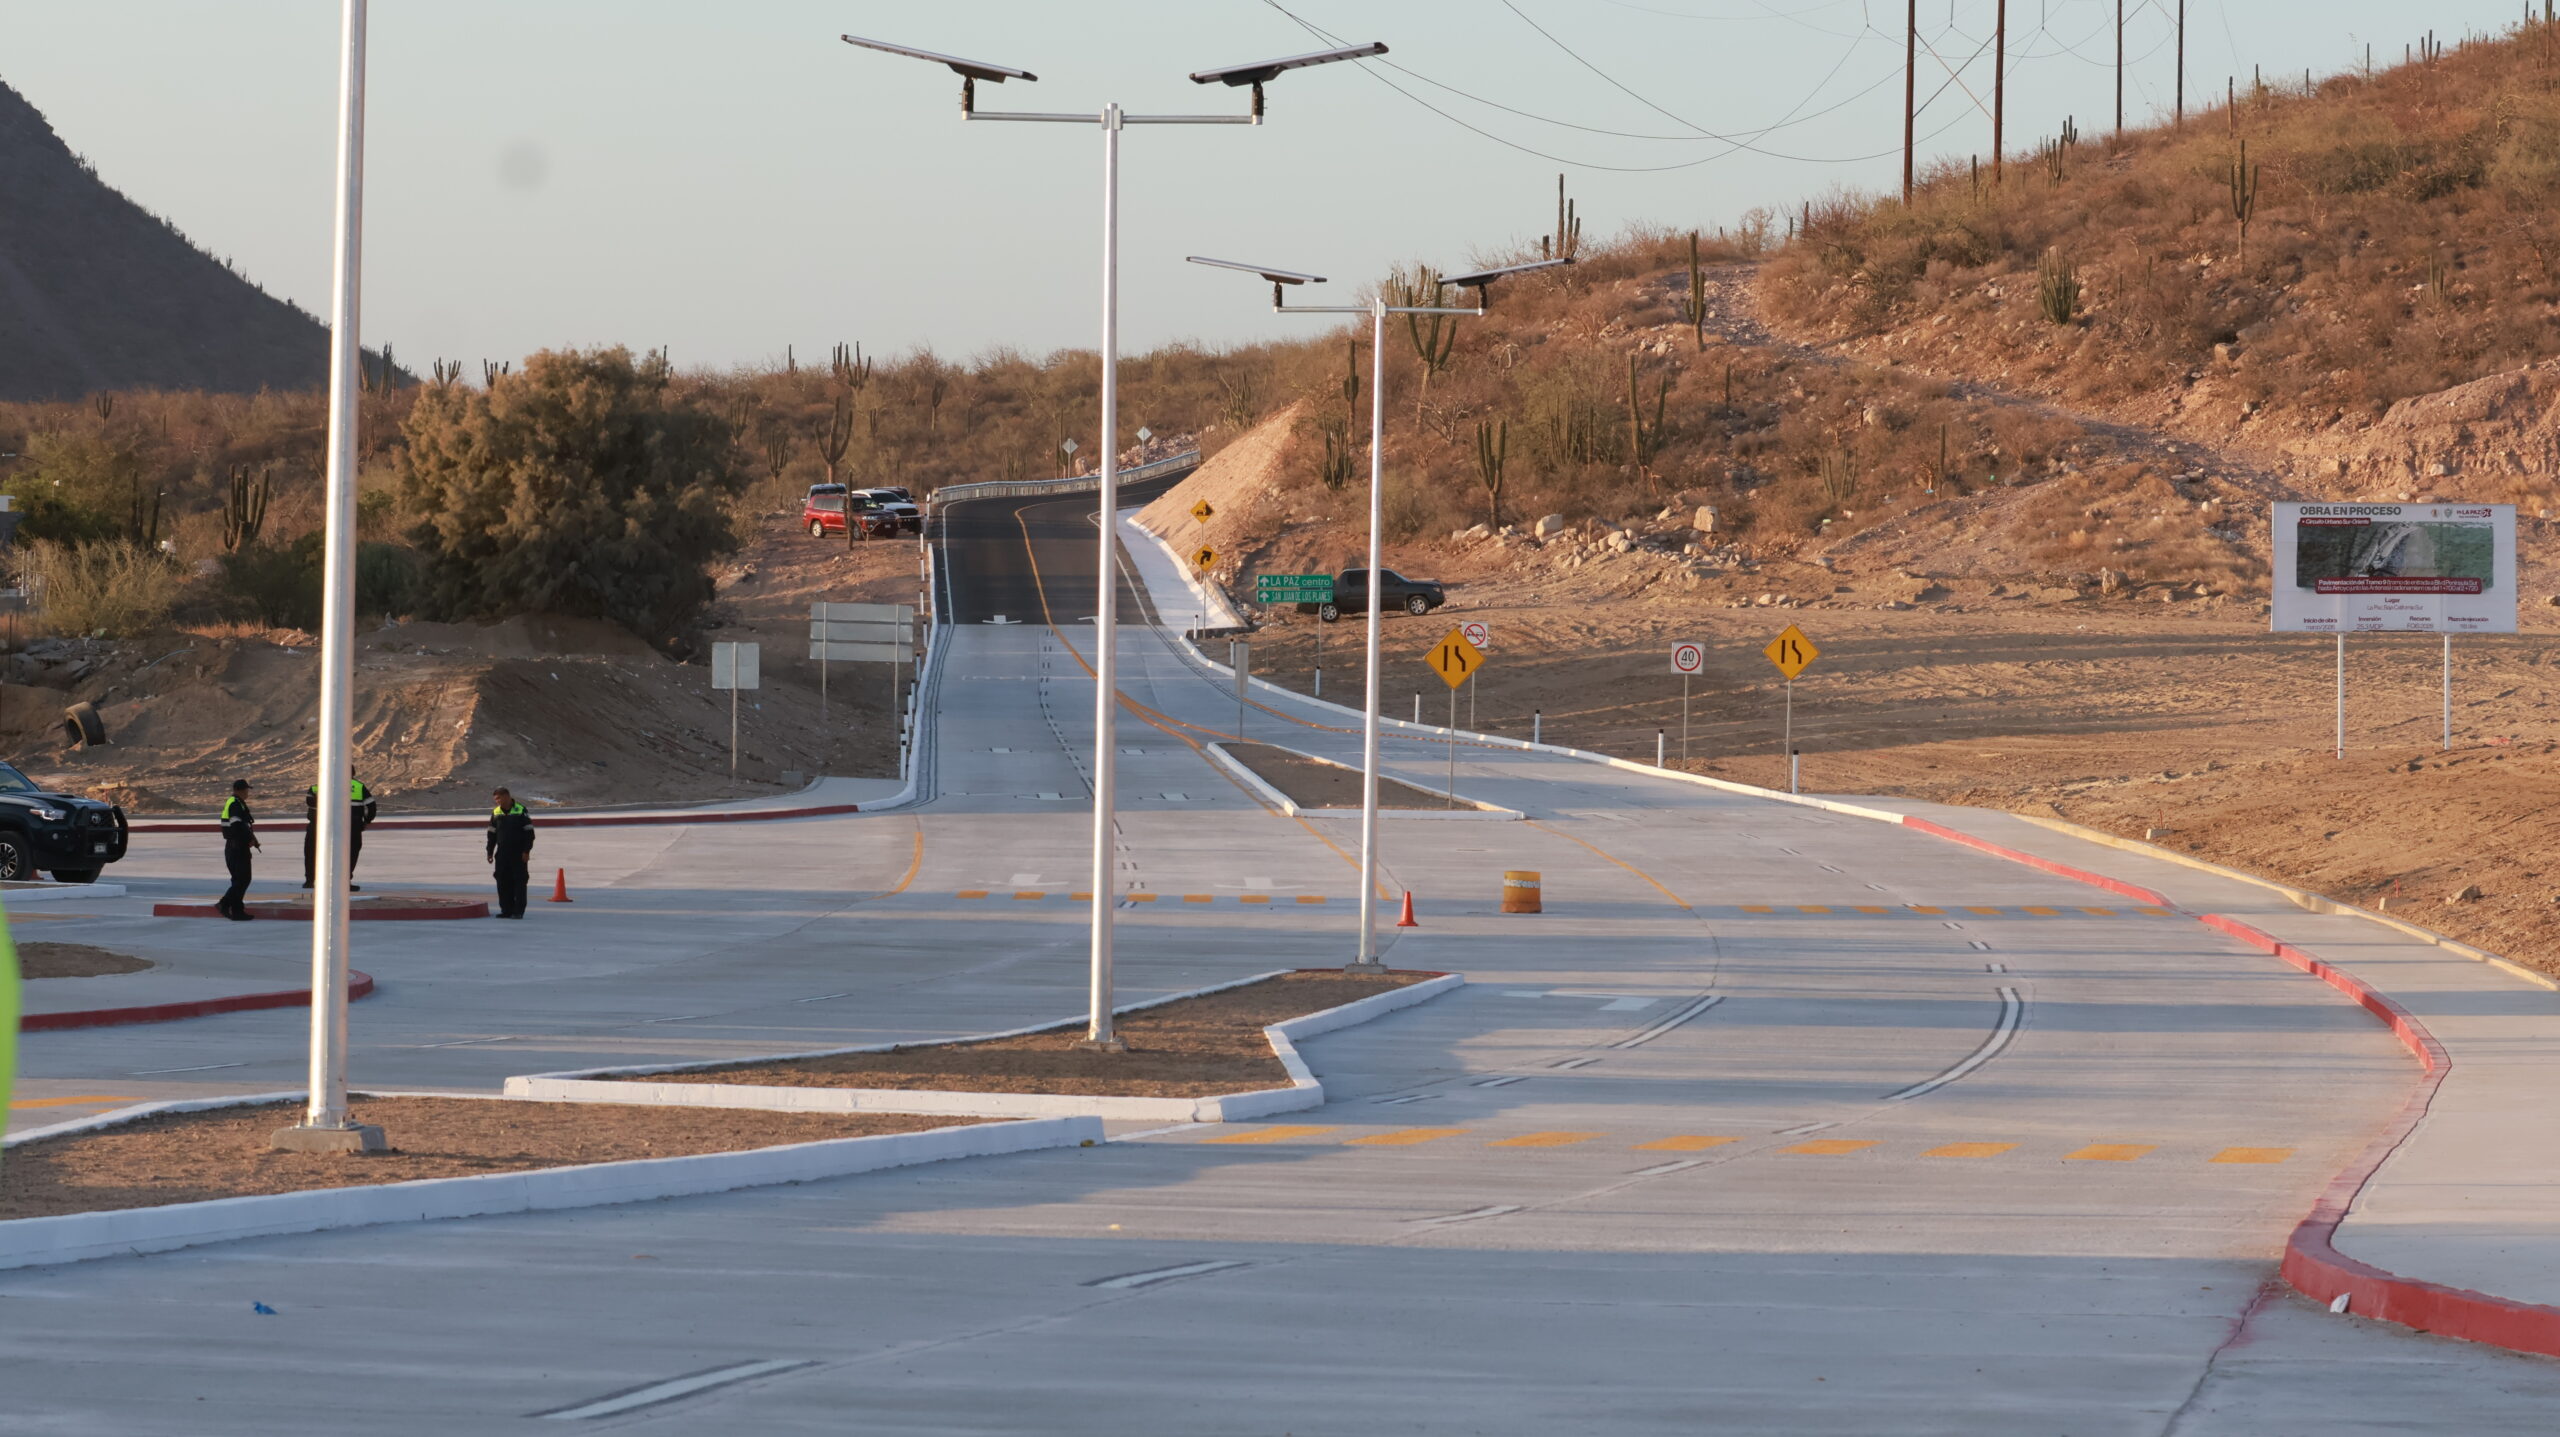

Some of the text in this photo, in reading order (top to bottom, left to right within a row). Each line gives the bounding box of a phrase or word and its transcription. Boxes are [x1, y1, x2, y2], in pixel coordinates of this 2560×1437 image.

[2300, 506, 2402, 516] OBRA EN PROCESO
[1270, 576, 1330, 586] LA PAZ centro
[1272, 592, 1330, 601] SAN JUAN DE LOS PLANES
[1681, 650, 1695, 662] 40
